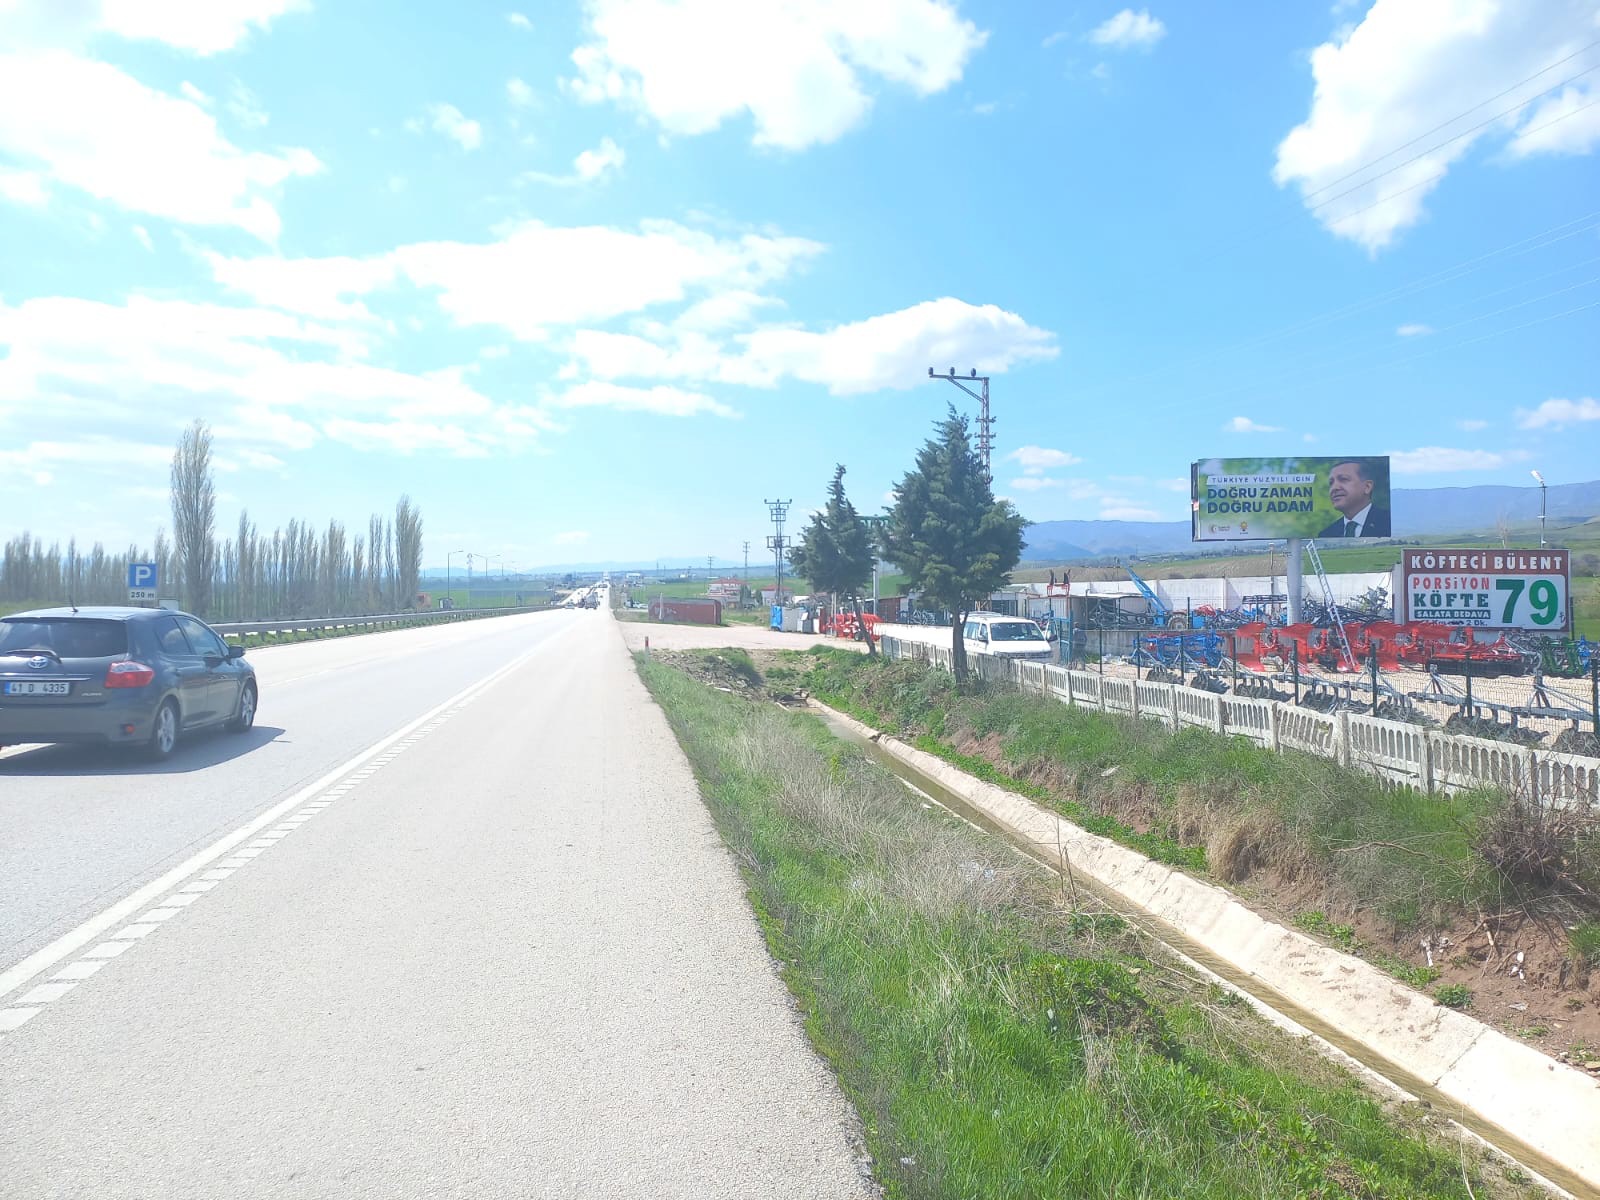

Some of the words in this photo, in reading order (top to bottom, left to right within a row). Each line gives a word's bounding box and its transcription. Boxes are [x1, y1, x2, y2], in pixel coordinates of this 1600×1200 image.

[1208, 487, 1257, 499] DOĞRU
[1260, 487, 1313, 498] ZAMAN
[1208, 500, 1263, 513] DOĞRU
[1266, 501, 1313, 512] ADAM
[1411, 552, 1487, 569] KÖFTECİ
[1494, 553, 1562, 570] BÜLENT
[136, 566, 151, 586] P
[1413, 590, 1489, 607] KÖFTE
[1496, 579, 1559, 625] 79
[1417, 610, 1451, 618] SALATA
[1454, 610, 1489, 618] BEDAVA
[11, 683, 23, 693] 41
[27, 683, 34, 693] D
[42, 683, 66, 693] 4335
